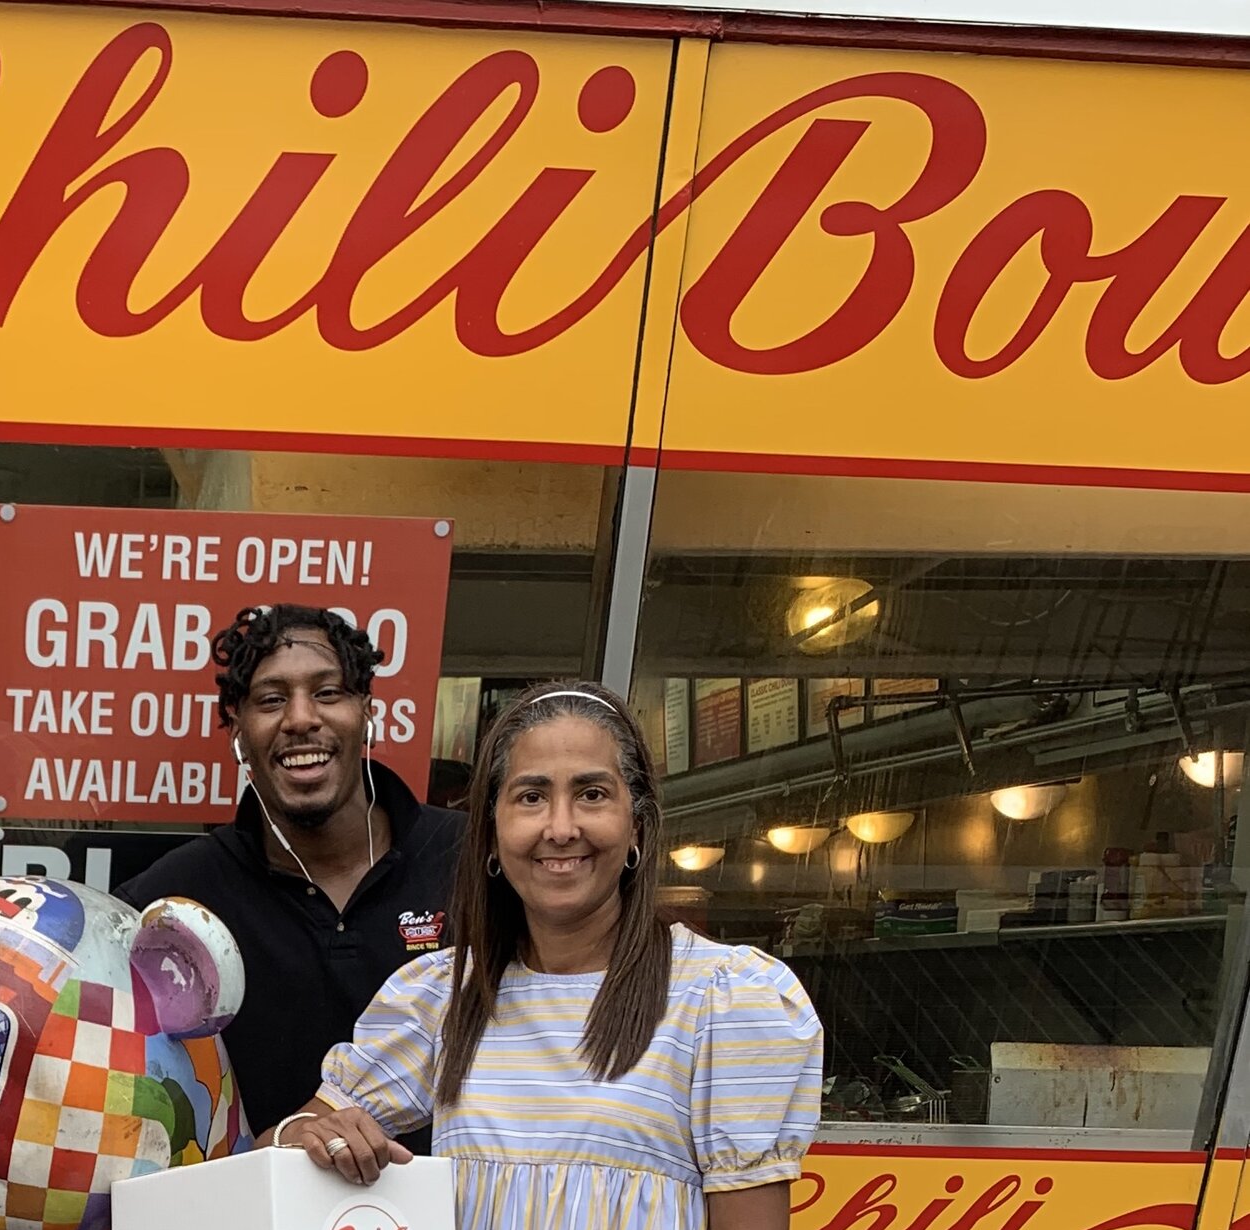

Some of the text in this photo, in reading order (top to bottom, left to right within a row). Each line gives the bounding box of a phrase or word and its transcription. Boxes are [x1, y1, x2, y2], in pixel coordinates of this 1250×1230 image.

[679, 71, 1250, 386] Bow
[74, 531, 374, 587] WE'RE OPEN!
[24, 598, 213, 672] GRAB
[6, 688, 221, 739] TAKE OUT
[398, 910, 434, 926] Ben's
